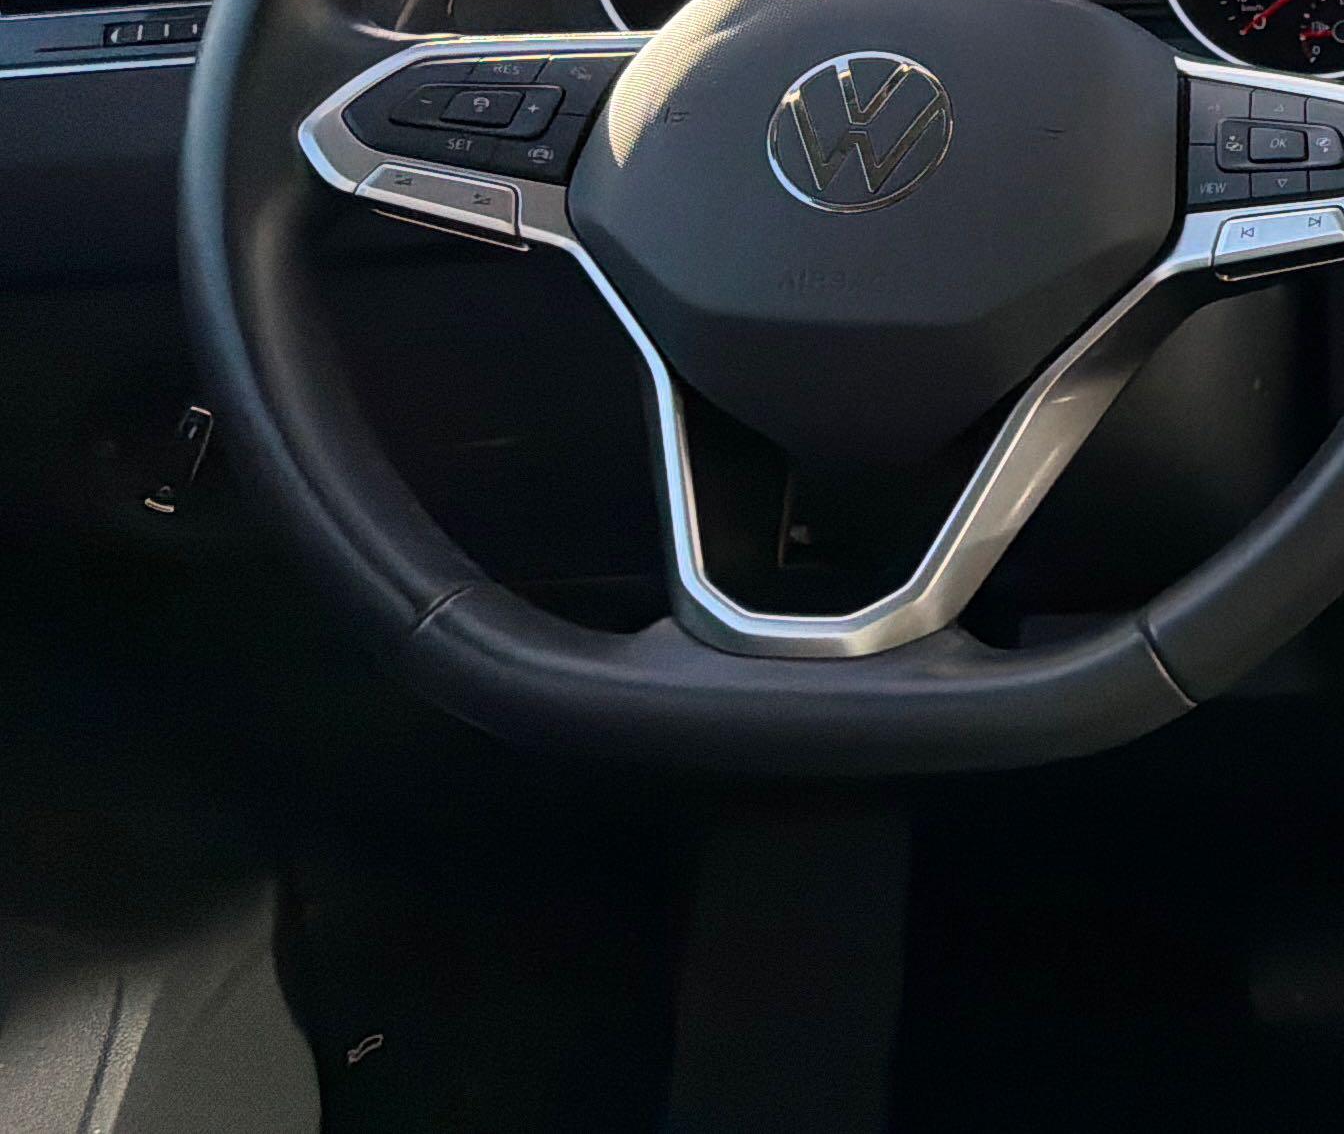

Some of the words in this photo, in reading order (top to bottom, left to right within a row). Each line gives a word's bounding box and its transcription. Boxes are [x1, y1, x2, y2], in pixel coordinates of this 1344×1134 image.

[447, 138, 474, 152] SET
[1269, 138, 1287, 149] OK
[1200, 182, 1227, 195] VIEW
